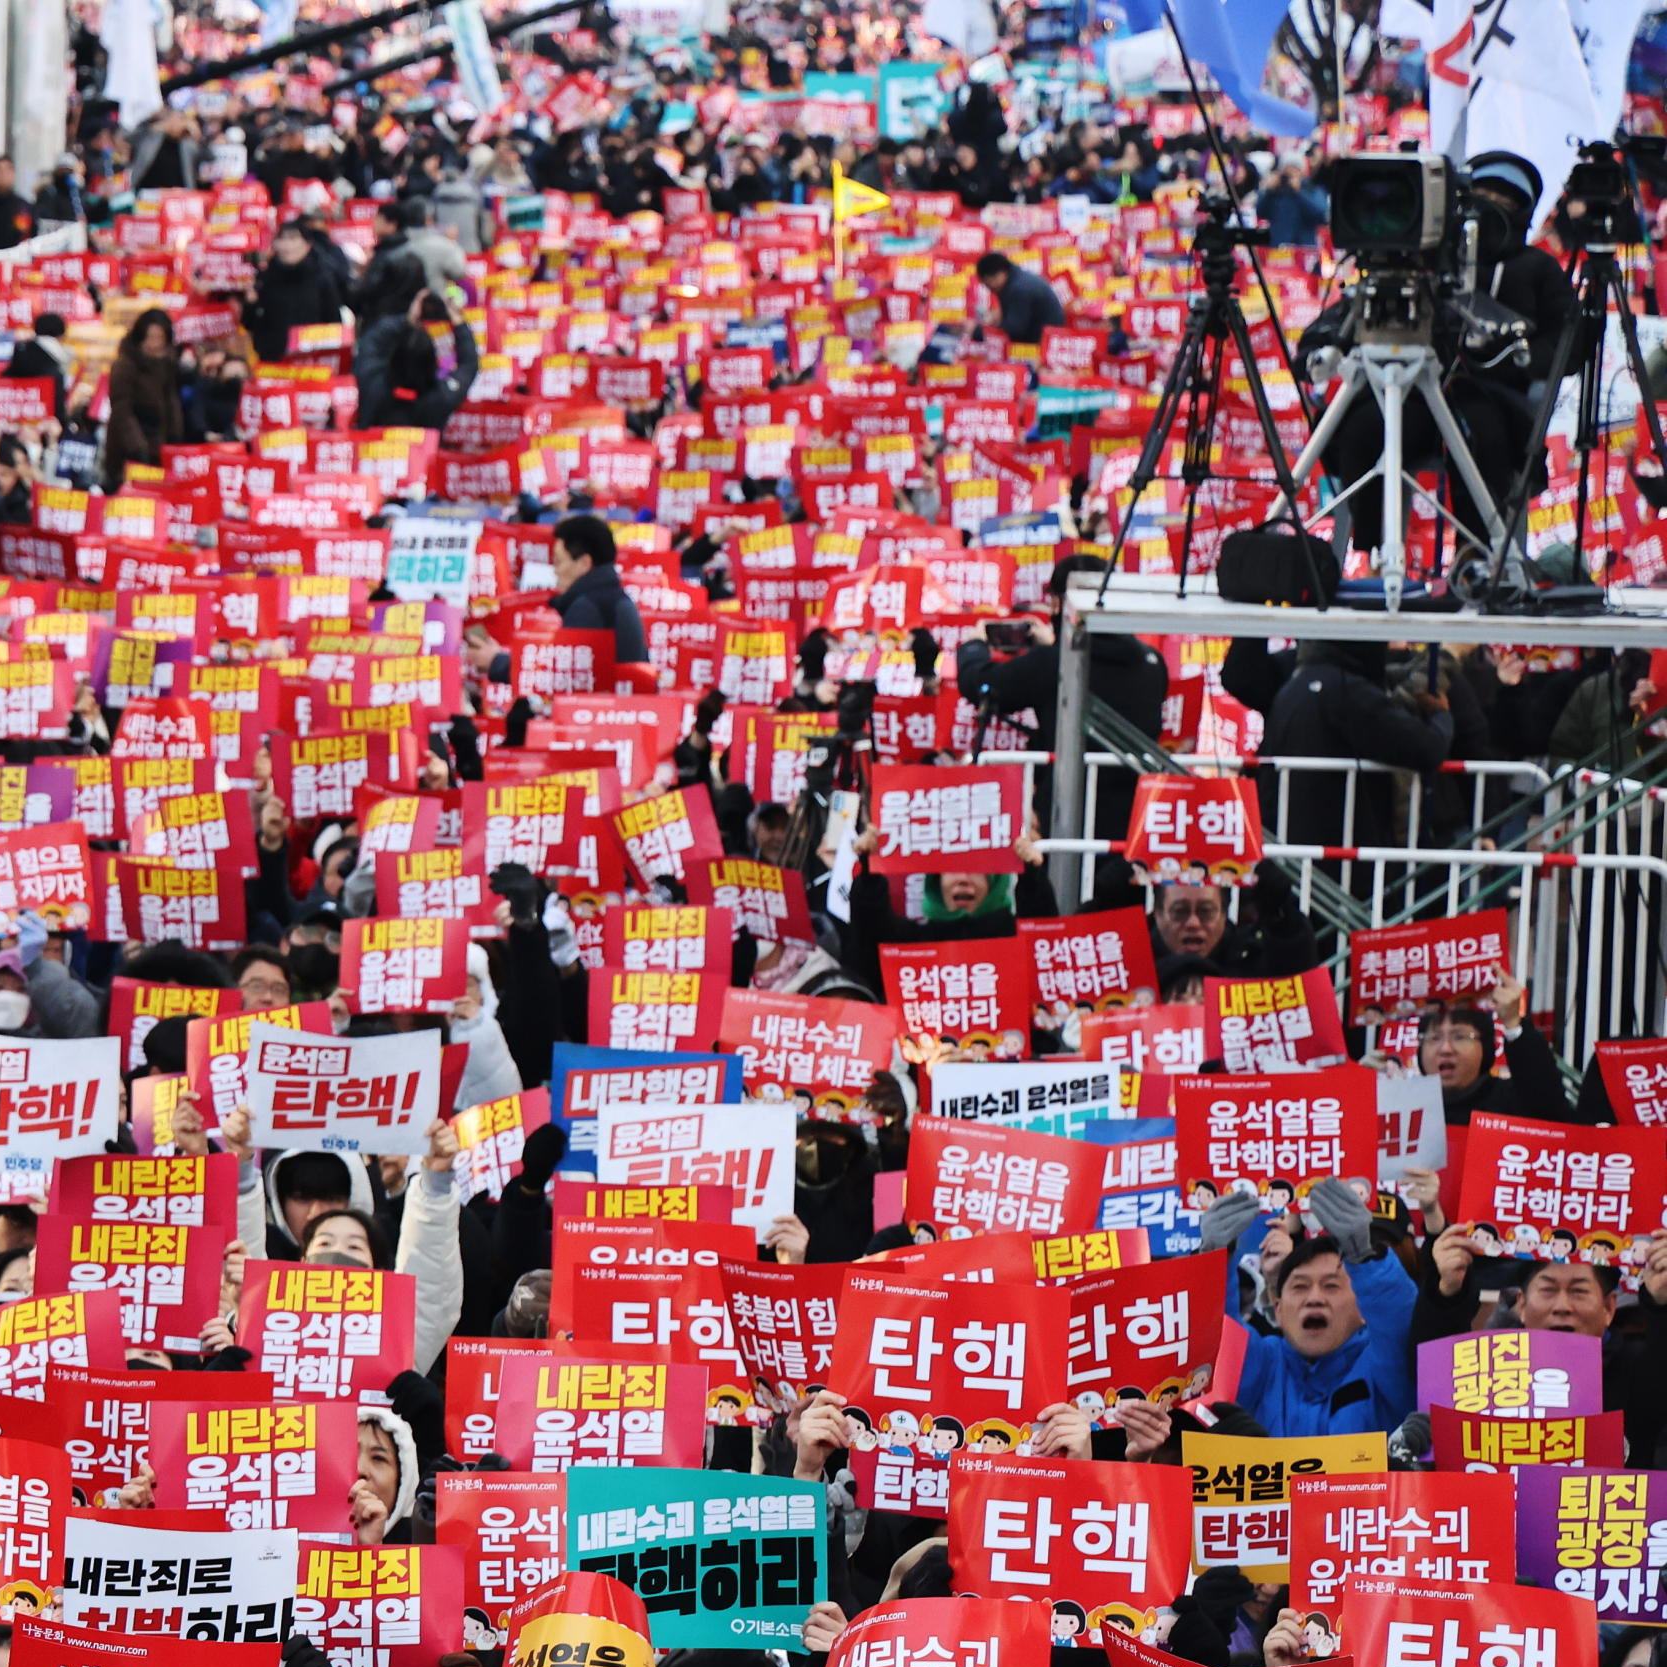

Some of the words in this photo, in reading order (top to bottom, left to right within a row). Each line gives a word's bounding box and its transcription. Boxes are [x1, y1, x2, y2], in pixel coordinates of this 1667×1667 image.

[836, 584, 906, 620] 탄핵
[881, 781, 1001, 822] 윤석열을
[879, 820, 1011, 856] 거부한다!
[20, 844, 81, 872] 힘으로
[20, 871, 86, 900] 지키자
[1359, 944, 1429, 978] 촛불의
[1433, 936, 1503, 966] 힘으로
[1361, 973, 1428, 998] 나라를
[1208, 1098, 1344, 1137] 윤석열을
[5, 1156, 42, 1170] 민주당
[1209, 1138, 1345, 1176] 탄핵하라
[1496, 1144, 1634, 1190] 윤석열을
[1492, 1184, 1633, 1231] 탄핵하라
[868, 1315, 1028, 1409] 탄핵
[577, 1501, 695, 1551] 내란수괴
[703, 1494, 817, 1537] 윤석열을
[982, 1499, 1149, 1594] 탄핵
[64, 1556, 232, 1597] 내란죄로
[67, 1636, 148, 1656] www.nanum.com
